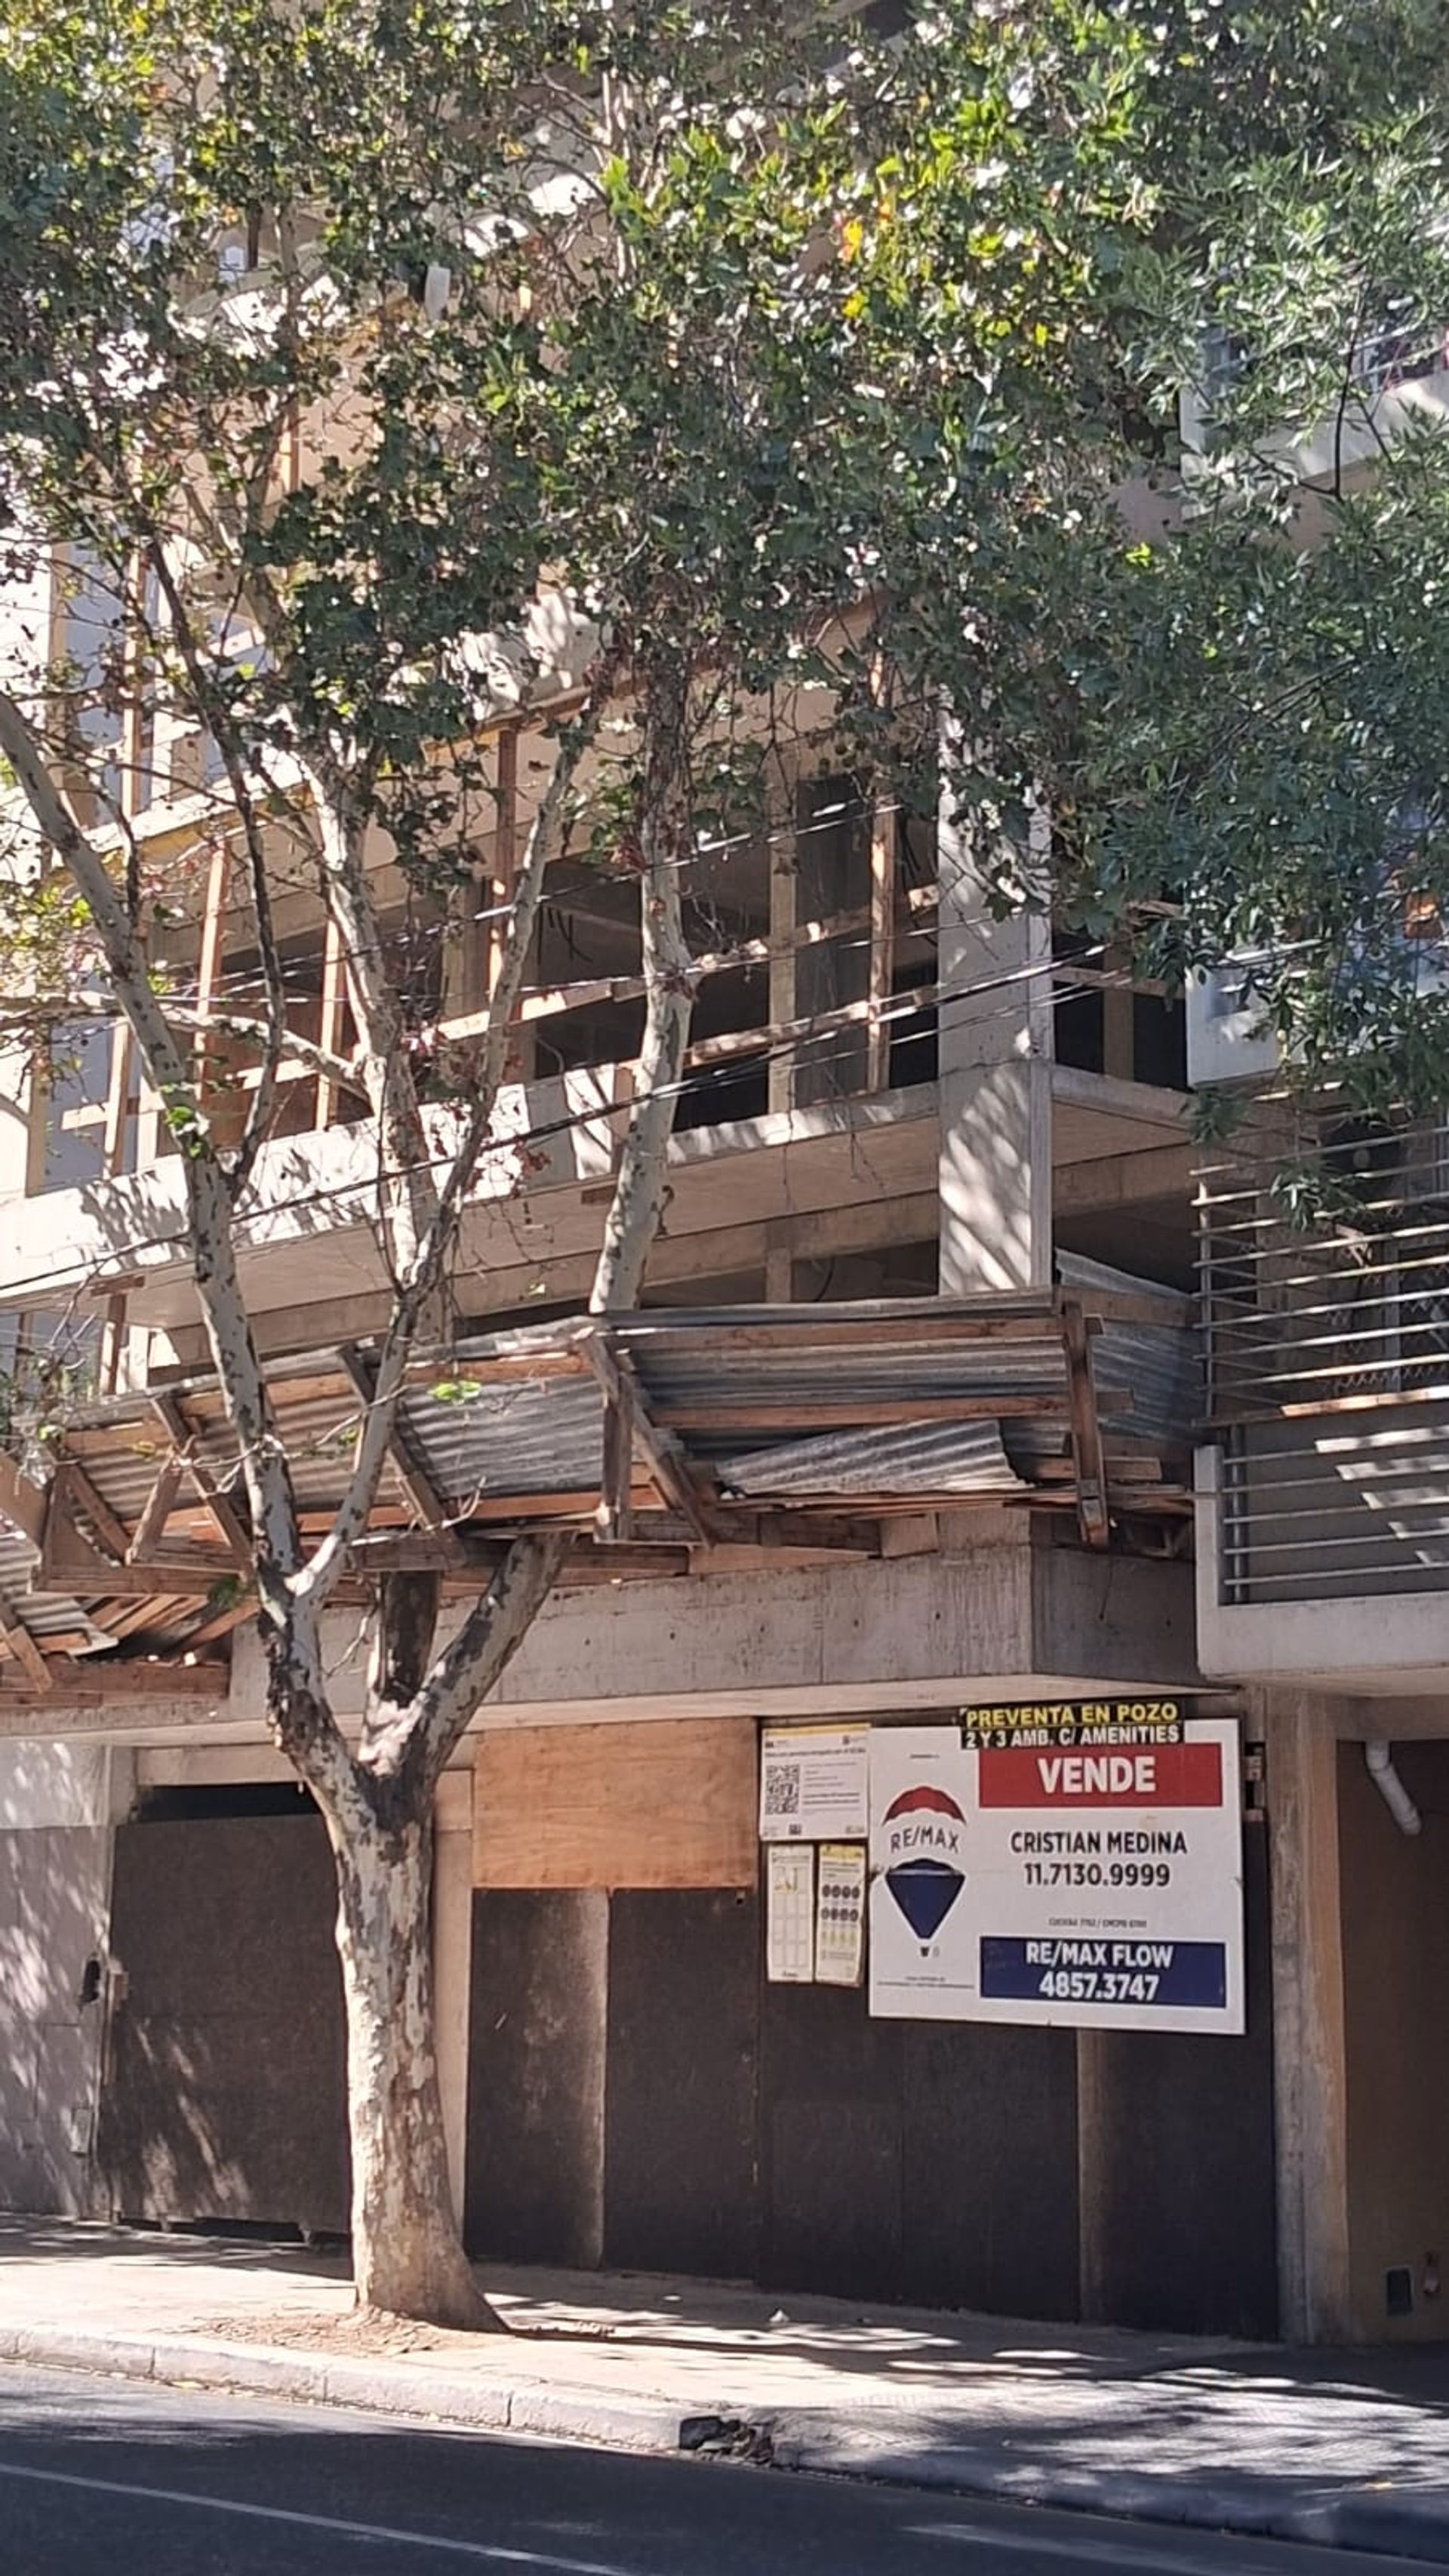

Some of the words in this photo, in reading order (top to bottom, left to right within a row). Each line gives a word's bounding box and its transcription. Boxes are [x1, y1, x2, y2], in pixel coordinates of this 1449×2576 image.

[966, 1707, 1075, 1728] PREVENTA
[1081, 1705, 1110, 1723] EN
[1117, 1703, 1178, 1722] POZO
[966, 1731, 977, 1749] 2
[980, 1730, 991, 1747] Y
[996, 1730, 1007, 1747] 3
[1010, 1728, 1054, 1747] AMB.
[1058, 1728, 1076, 1746] C/
[1080, 1725, 1180, 1745] AMENITIES
[1037, 1756, 1156, 1794] VENDE
[891, 1825, 959, 1854] RE/MAX
[1011, 1831, 1101, 1854] CRISTIAN
[1107, 1831, 1188, 1854] MEDINA
[1024, 1862, 1171, 1887] 11.7130.9999
[1026, 1940, 1107, 1967] RE/MAX
[1112, 1944, 1174, 1968] FLOW
[1038, 1971, 1160, 2002] 4857.3747
